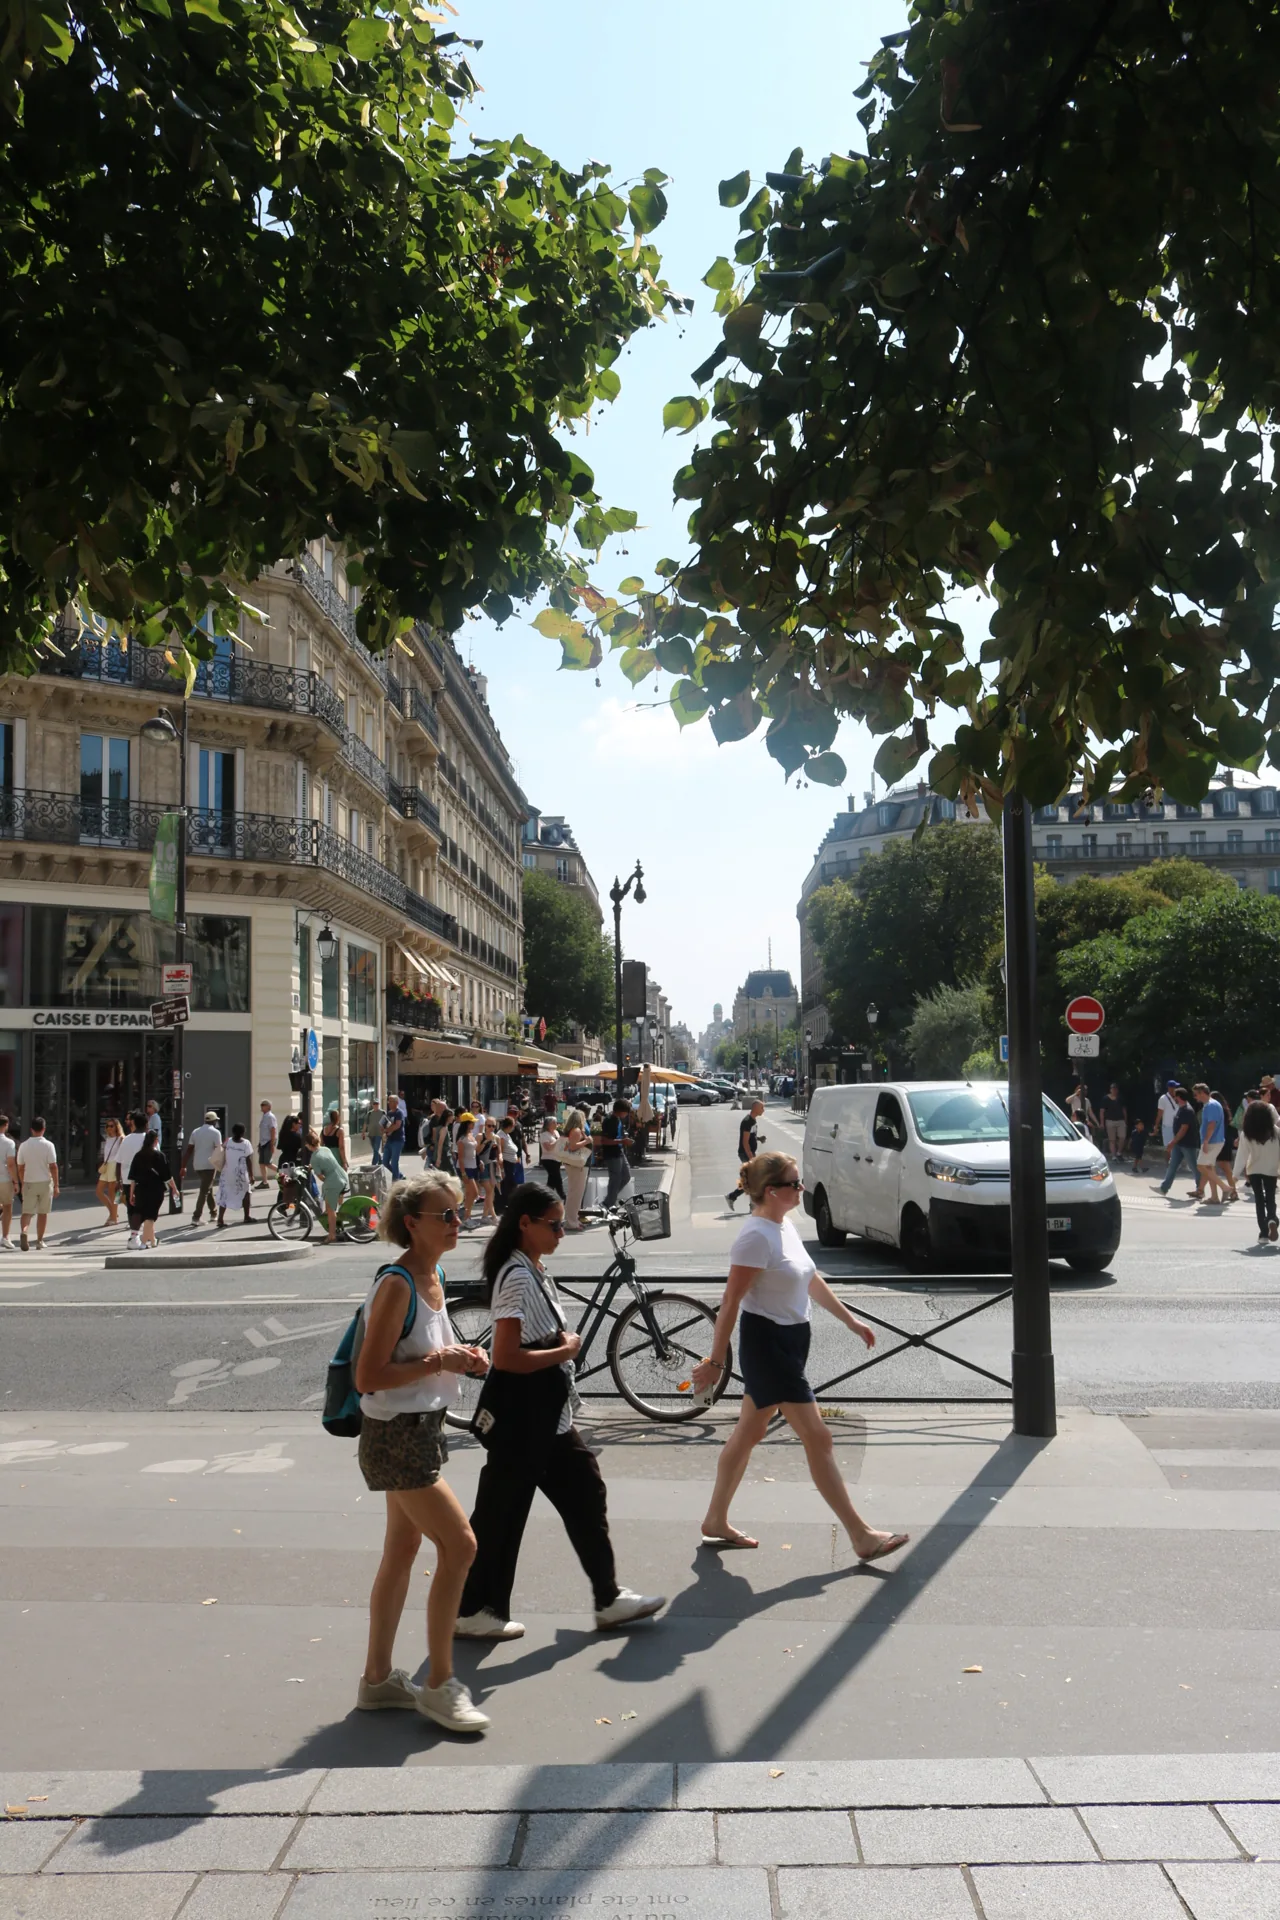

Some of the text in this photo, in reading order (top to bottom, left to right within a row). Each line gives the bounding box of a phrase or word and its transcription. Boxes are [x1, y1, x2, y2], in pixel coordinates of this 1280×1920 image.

[155, 841, 176, 862] 10
[33, 1012, 91, 1026] CAISSE
[369, 1893, 689, 1909] ont été plantés en ce lieu.
